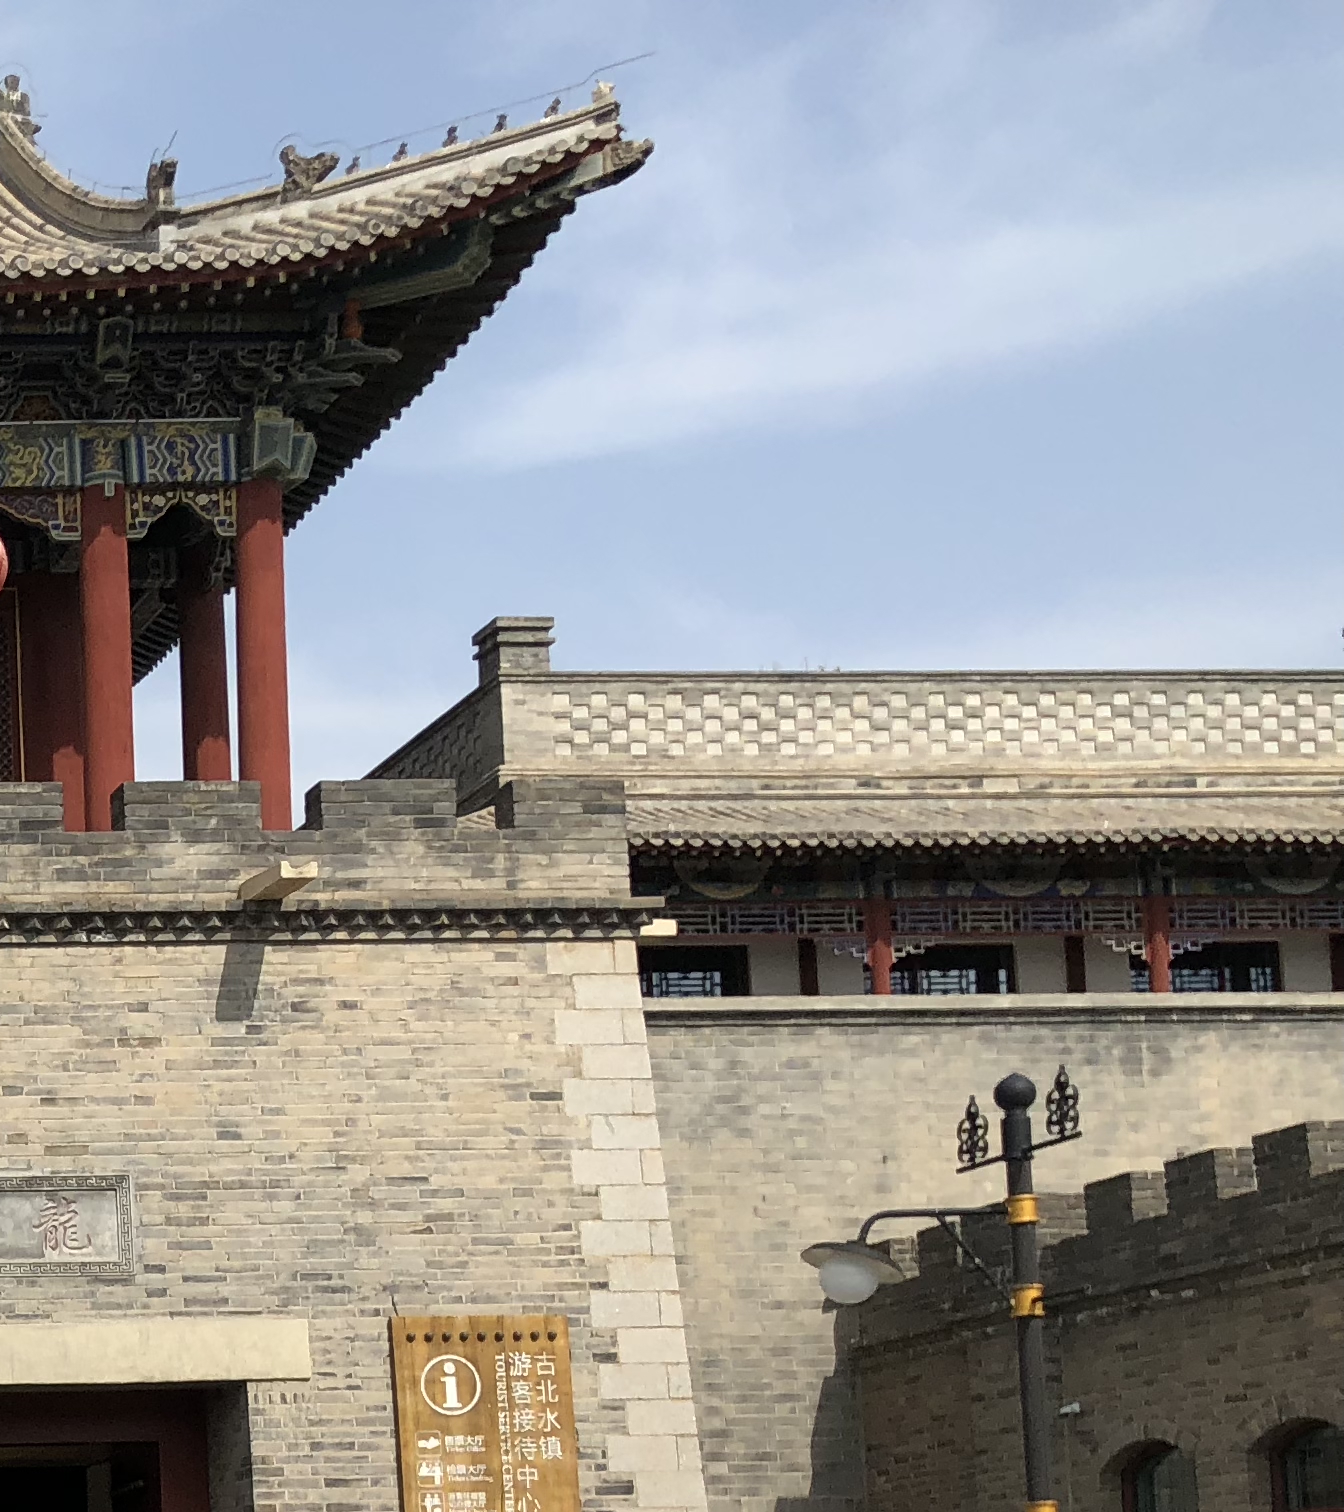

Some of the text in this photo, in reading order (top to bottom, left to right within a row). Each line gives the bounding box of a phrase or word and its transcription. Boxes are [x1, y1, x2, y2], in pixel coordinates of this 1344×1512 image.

[494, 1353, 509, 1410] TOURIST
[533, 1351, 563, 1460] 古北水镇
